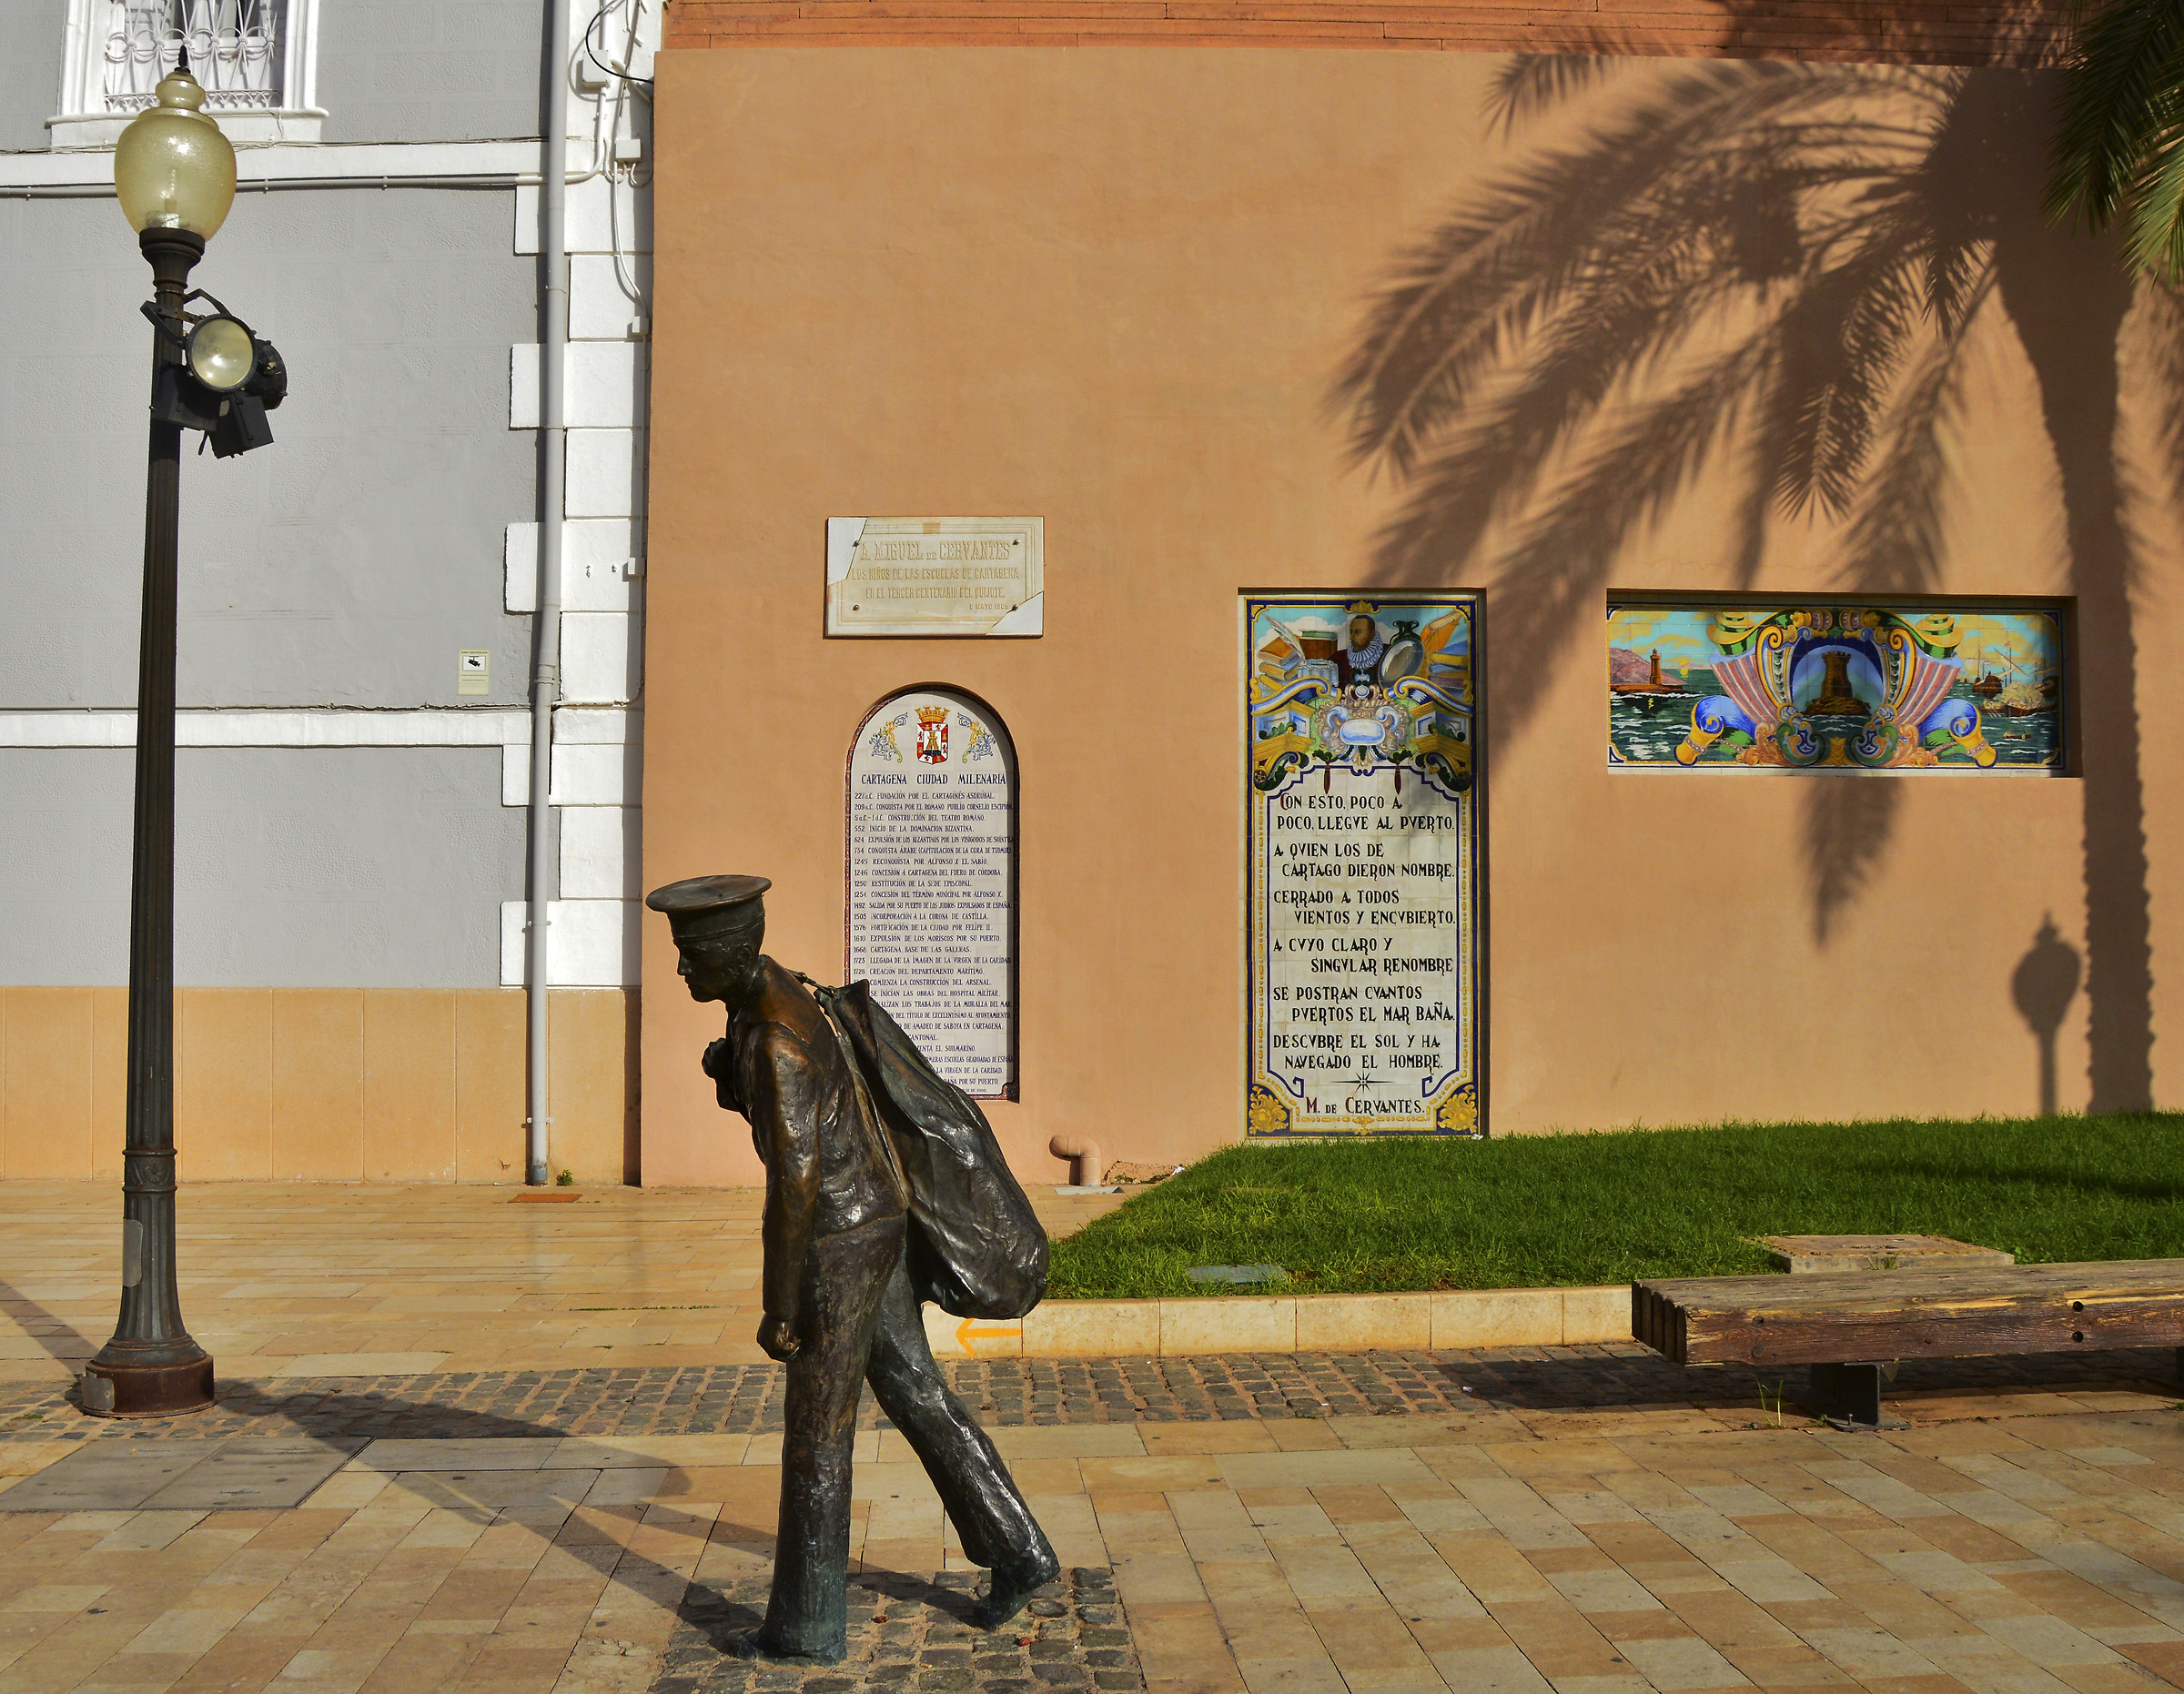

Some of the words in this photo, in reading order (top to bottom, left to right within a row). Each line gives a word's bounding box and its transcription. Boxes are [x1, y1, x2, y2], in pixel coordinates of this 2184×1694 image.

[860, 540, 871, 560] A
[875, 540, 924, 560] MIGUEL
[926, 552, 937, 560] DE
[940, 540, 1010, 560] CERVANTES
[852, 567, 866, 580] LOS
[869, 567, 891, 580] NIÑOS
[893, 567, 902, 580] DE
[905, 567, 919, 580] LAS
[922, 567, 959, 580] ESCUELAS
[963, 567, 972, 580] DE
[975, 567, 1019, 580] CARTAGENA
[865, 587, 875, 600] EN
[876, 587, 885, 600] EL
[887, 587, 914, 600] TERCER
[915, 587, 957, 600] CENTENARIO
[959, 587, 974, 600] DEL
[861, 773, 907, 785] CARTAGENA
[916, 773, 948, 785] CIUDAD
[957, 773, 1006, 785] MILENARIA
[908, 792, 919, 801] POR
[922, 792, 929, 801] EL
[1280, 792, 1302, 810] CON
[1308, 796, 1347, 809] ESTO,
[1350, 796, 1386, 809] POCO
[1391, 796, 1403, 809] A
[1277, 816, 1316, 830] POCO,
[1318, 816, 1369, 830] LLEGVE
[1376, 816, 1394, 830] AL
[1400, 816, 1456, 833] PVERTO.
[1274, 843, 1284, 857] A
[1289, 843, 1329, 861] QVIEN
[1335, 843, 1360, 857] LOS
[1366, 843, 1384, 857] DE
[1282, 863, 1341, 882] CARTAGO
[1348, 863, 1396, 882] DIERON
[1401, 863, 1456, 882] NOMBRE.
[1273, 890, 1334, 908] CERRADO
[1341, 890, 1351, 903] A
[1357, 890, 1400, 903] TODOS
[1294, 911, 1350, 924] VIENTOS
[1356, 911, 1365, 924] Y
[1370, 911, 1456, 928] ENCVBIERTO.
[1273, 938, 1283, 952] A
[1289, 938, 1325, 952] CVYO
[1331, 938, 1378, 955] CLARO
[1382, 938, 1392, 952] Y
[1310, 957, 1378, 976] SINGVLAR
[1383, 957, 1453, 976] RENOMBRE
[1273, 986, 1289, 1000] SE
[1296, 986, 1358, 1004] POSTRAN
[1364, 986, 1422, 1000] CVANTOS
[1291, 1006, 1354, 1025] PVERTOS
[1360, 1006, 1377, 1022] EL
[1383, 1006, 1410, 1025] MAR
[1416, 1002, 1455, 1022] BAÑA.
[1273, 1034, 1343, 1053] DESCVBRE
[1350, 1034, 1367, 1048] EL
[1374, 1034, 1400, 1048] SOL
[1406, 1034, 1416, 1048] Y
[1421, 1034, 1441, 1048] HA
[1284, 1054, 1352, 1069] NAVEGADO
[1361, 1054, 1378, 1069] EL
[1389, 1054, 1443, 1075] HOMBRE.
[1306, 1096, 1320, 1114] M.
[1325, 1104, 1337, 1114] DE
[1344, 1096, 1426, 1116] CERVANTES.
